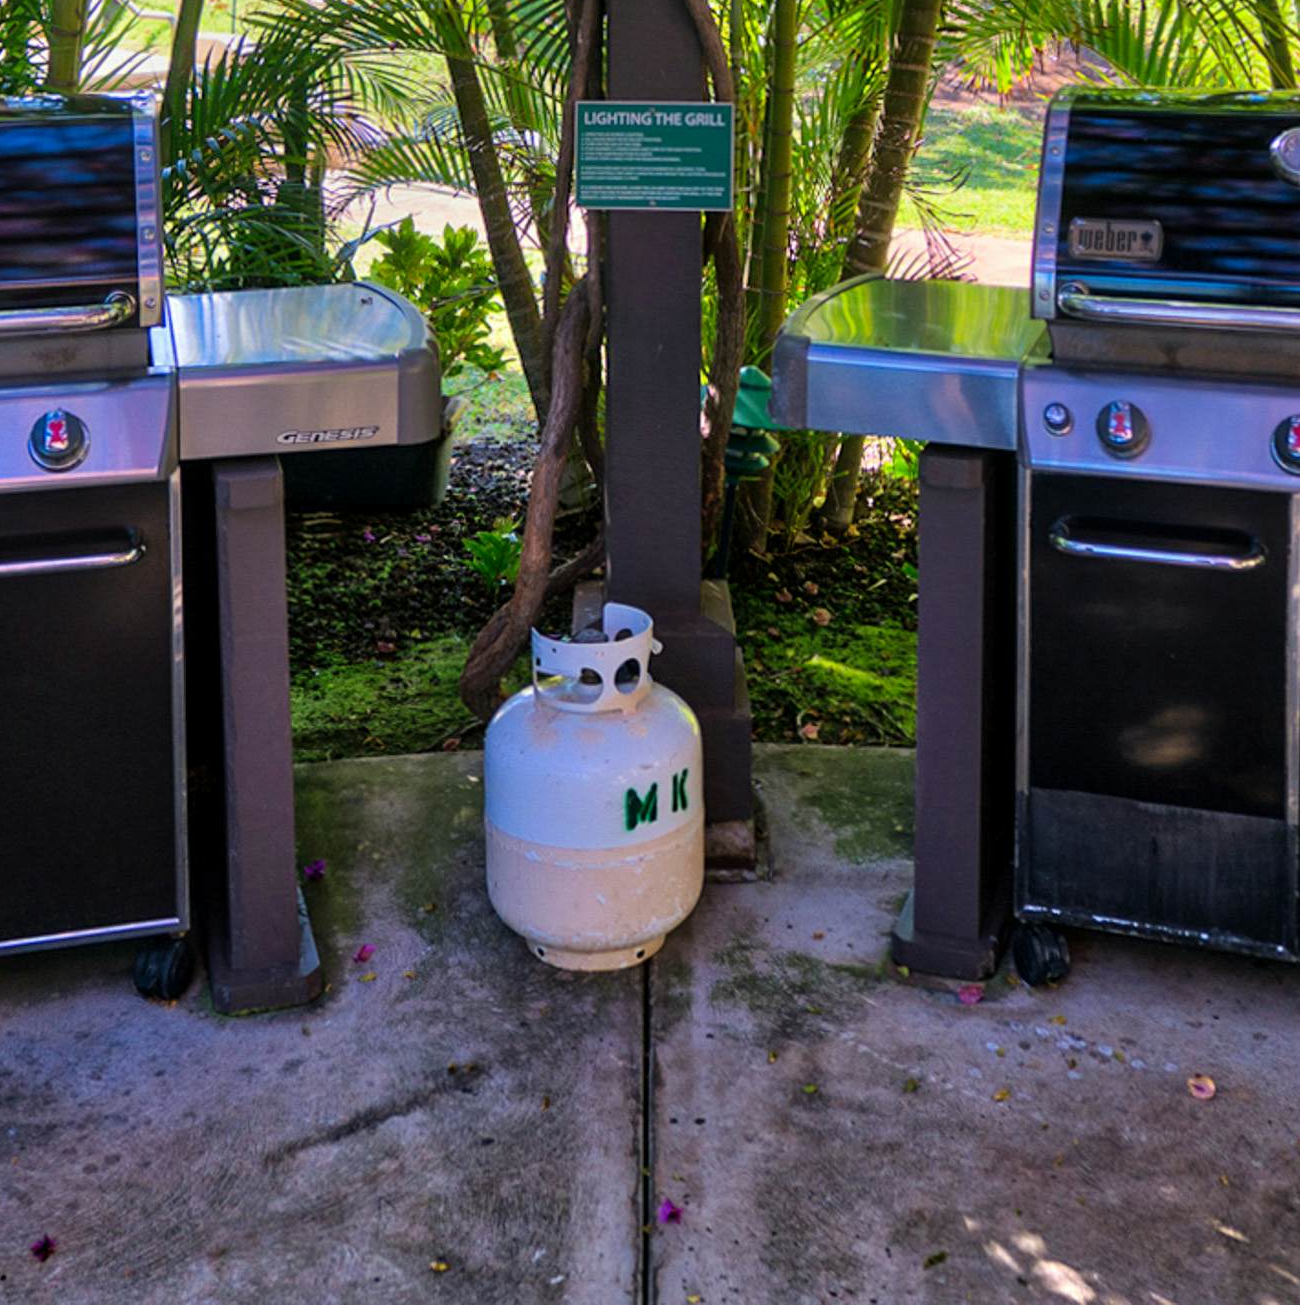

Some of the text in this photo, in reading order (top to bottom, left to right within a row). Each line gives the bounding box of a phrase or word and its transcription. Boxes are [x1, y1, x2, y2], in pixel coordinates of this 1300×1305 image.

[583, 111, 725, 127] LIGHTING THE GRILL
[1078, 221, 1137, 252] weber
[277, 426, 379, 444] GENESIS
